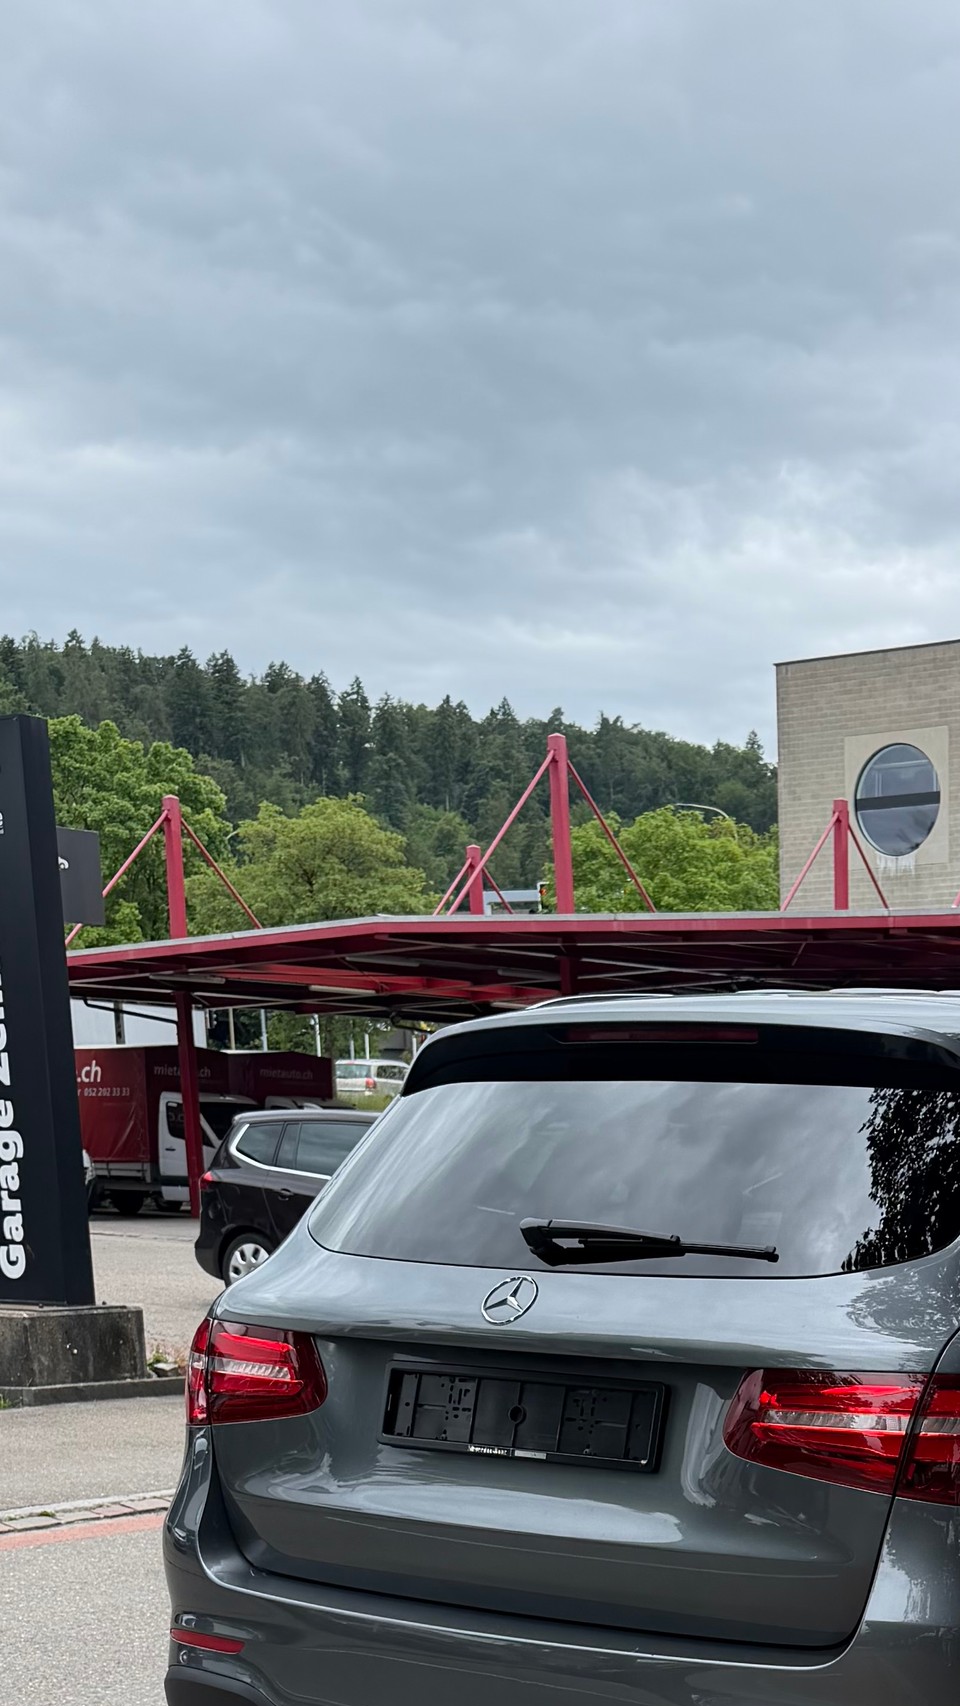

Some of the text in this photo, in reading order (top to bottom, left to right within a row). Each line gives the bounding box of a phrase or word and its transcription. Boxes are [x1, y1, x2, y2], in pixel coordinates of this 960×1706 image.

[76, 1060, 102, 1083] .ch
[84, 1087, 97, 1097] 052
[112, 1087, 121, 1097] 33
[121, 1087, 130, 1097] 33
[0, 1100, 26, 1280] Garage
